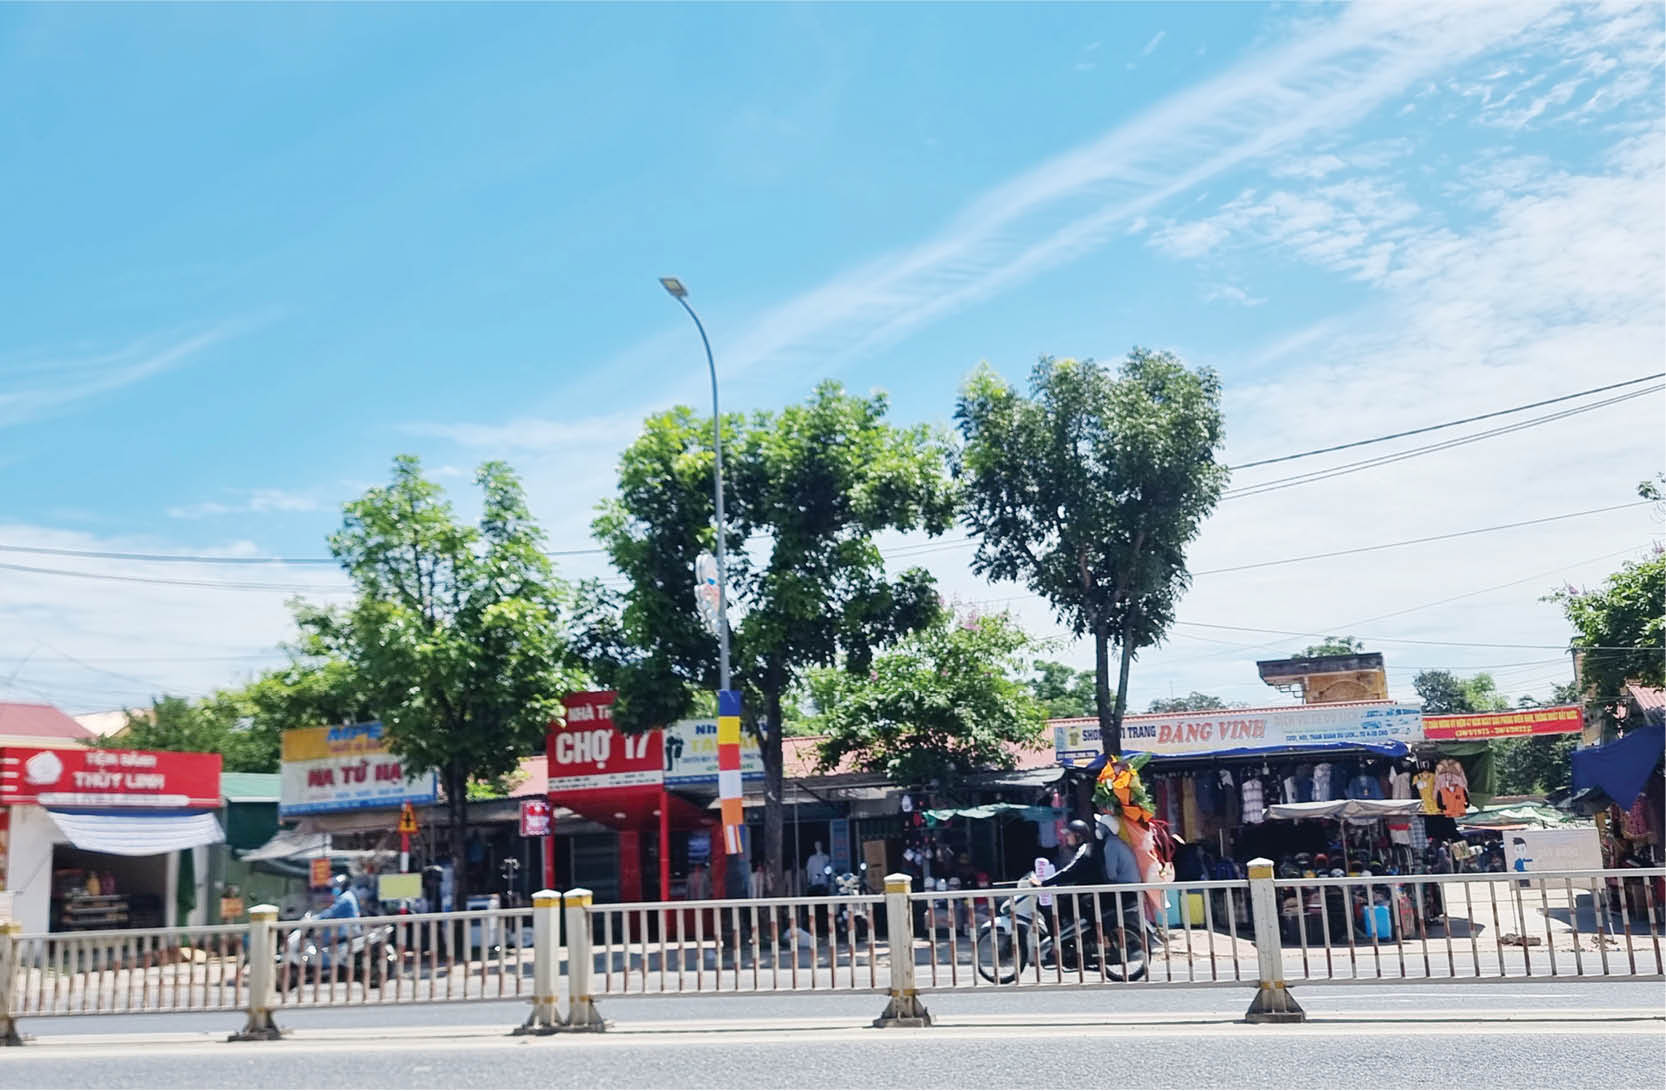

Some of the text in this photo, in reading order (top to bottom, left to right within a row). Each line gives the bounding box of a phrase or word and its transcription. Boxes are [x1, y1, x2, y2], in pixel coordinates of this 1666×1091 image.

[1127, 726, 1156, 739] TRANG
[1217, 719, 1265, 741] VINH
[556, 729, 612, 769] CHỢ
